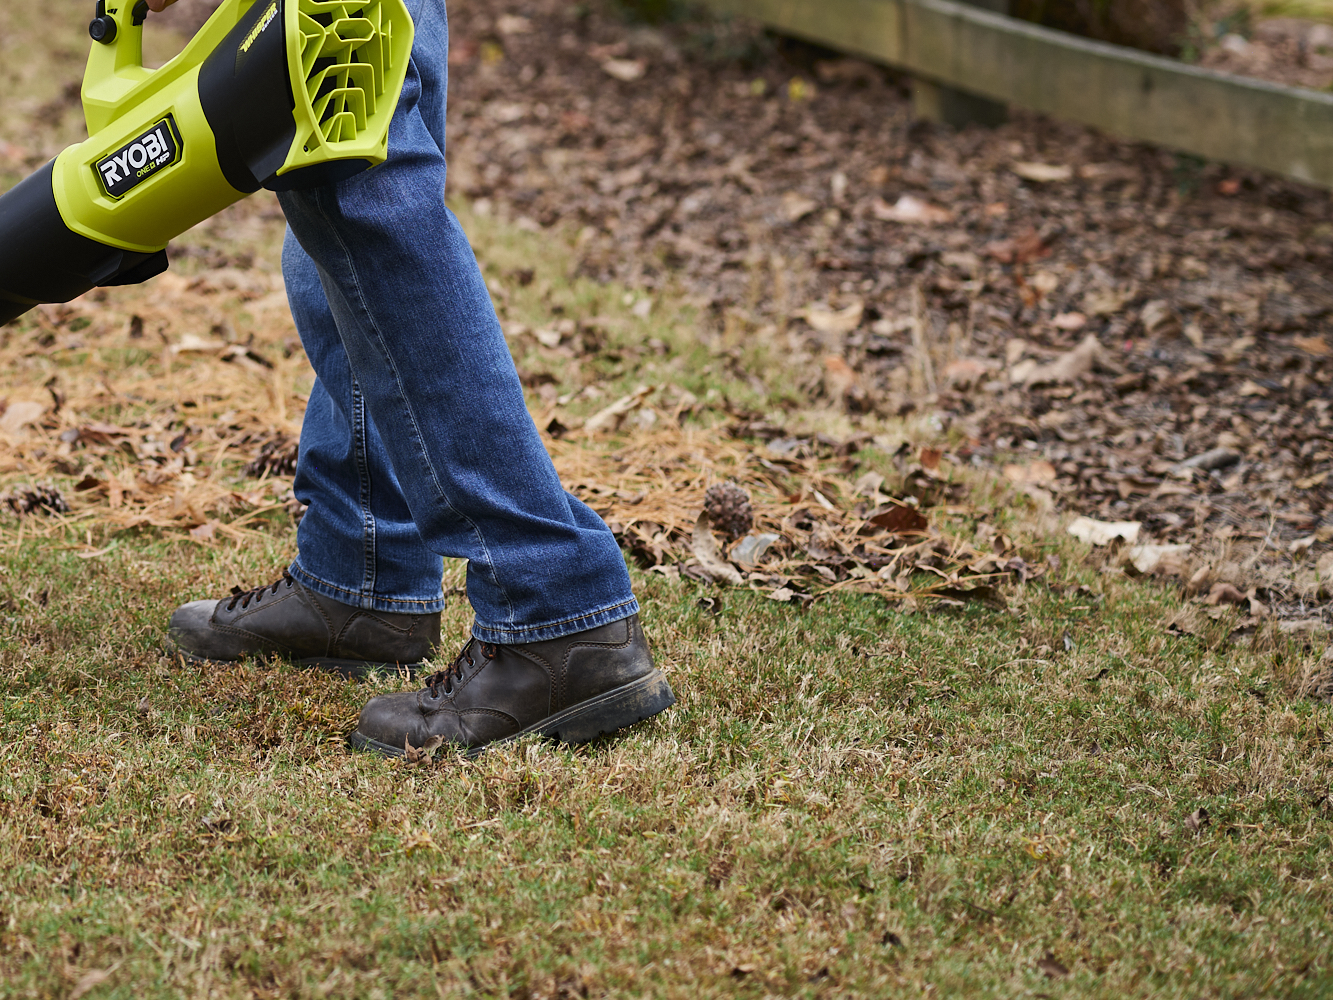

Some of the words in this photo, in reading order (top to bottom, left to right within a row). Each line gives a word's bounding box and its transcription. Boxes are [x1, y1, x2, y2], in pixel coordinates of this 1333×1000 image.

[239, 2, 277, 53] WHISPER
[99, 128, 168, 187] RYOBI
[155, 151, 170, 166] HP
